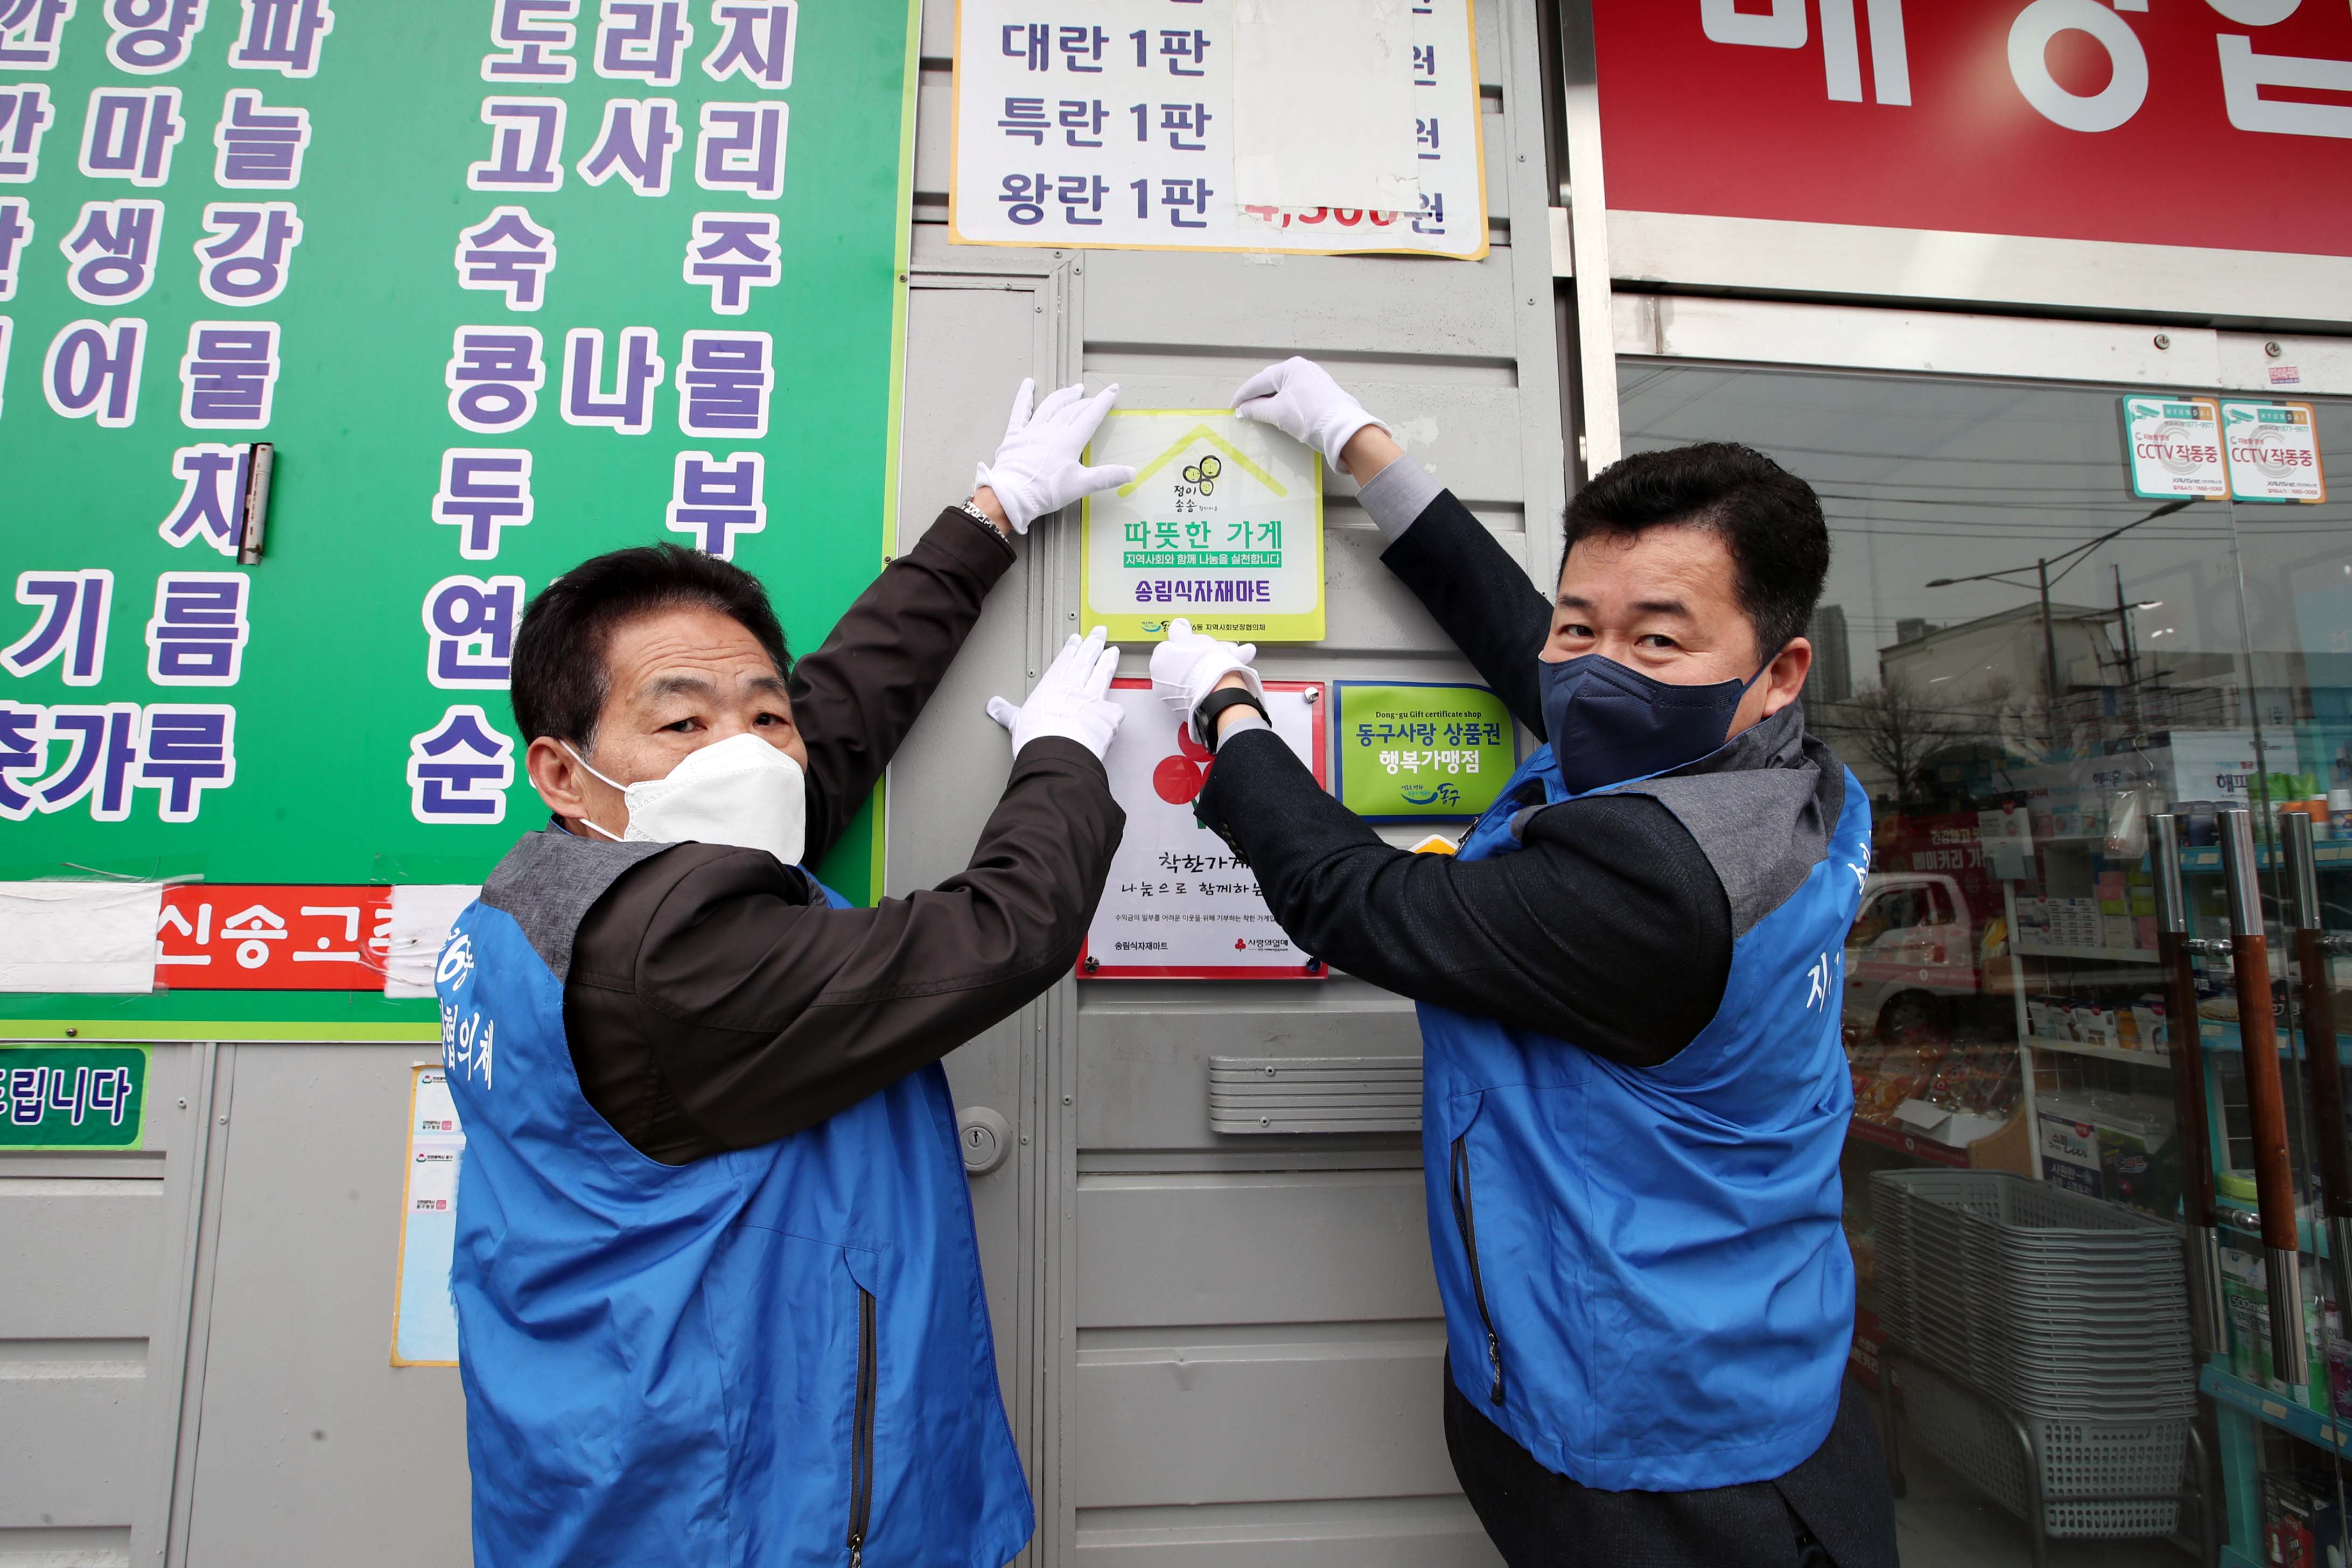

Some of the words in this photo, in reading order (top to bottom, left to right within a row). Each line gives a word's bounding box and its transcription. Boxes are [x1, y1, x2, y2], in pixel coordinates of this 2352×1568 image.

[491, 0, 788, 81] 도라지
[1002, 24, 1109, 73] 대란
[1130, 29, 1210, 76] 1판
[997, 97, 1109, 148] 특란
[1130, 103, 1212, 150] 1판
[477, 104, 780, 191] 고사리
[998, 173, 1109, 226] 왕란
[1130, 178, 1213, 228] 1판
[0, 327, 271, 420] 어물
[456, 335, 765, 430] 콩나물
[2137, 444, 2173, 459] CCTV
[2176, 445, 2218, 463] 작동중
[2232, 448, 2268, 463] CCTV
[2271, 449, 2313, 466] 작동중
[1175, 499, 1198, 513] 송송
[1124, 521, 1211, 549] 따뜻한
[1227, 521, 1282, 549] 가게
[1126, 554, 1175, 565] 지역사회와
[1177, 554, 1196, 565] 함께
[1199, 554, 1228, 565] 나눔을
[1231, 554, 1280, 565] 실천합니다
[1135, 580, 1271, 602] 송림식자재마트
[10, 579, 240, 676] 기름
[1376, 711, 1408, 720] Dong-gu
[1464, 711, 1481, 719] shop
[1356, 723, 1437, 747] 동구사랑
[1443, 723, 1501, 745] 상품권
[418, 716, 504, 814] 순
[1379, 750, 1480, 775] 행복가맹점
[1437, 783, 1461, 807] 동구
[1122, 881, 1188, 897] 나눔으로
[1199, 881, 1263, 897] 함께하는
[1115, 941, 1168, 950] 송림식자재마트
[1248, 939, 1288, 948] 사랑의열매
